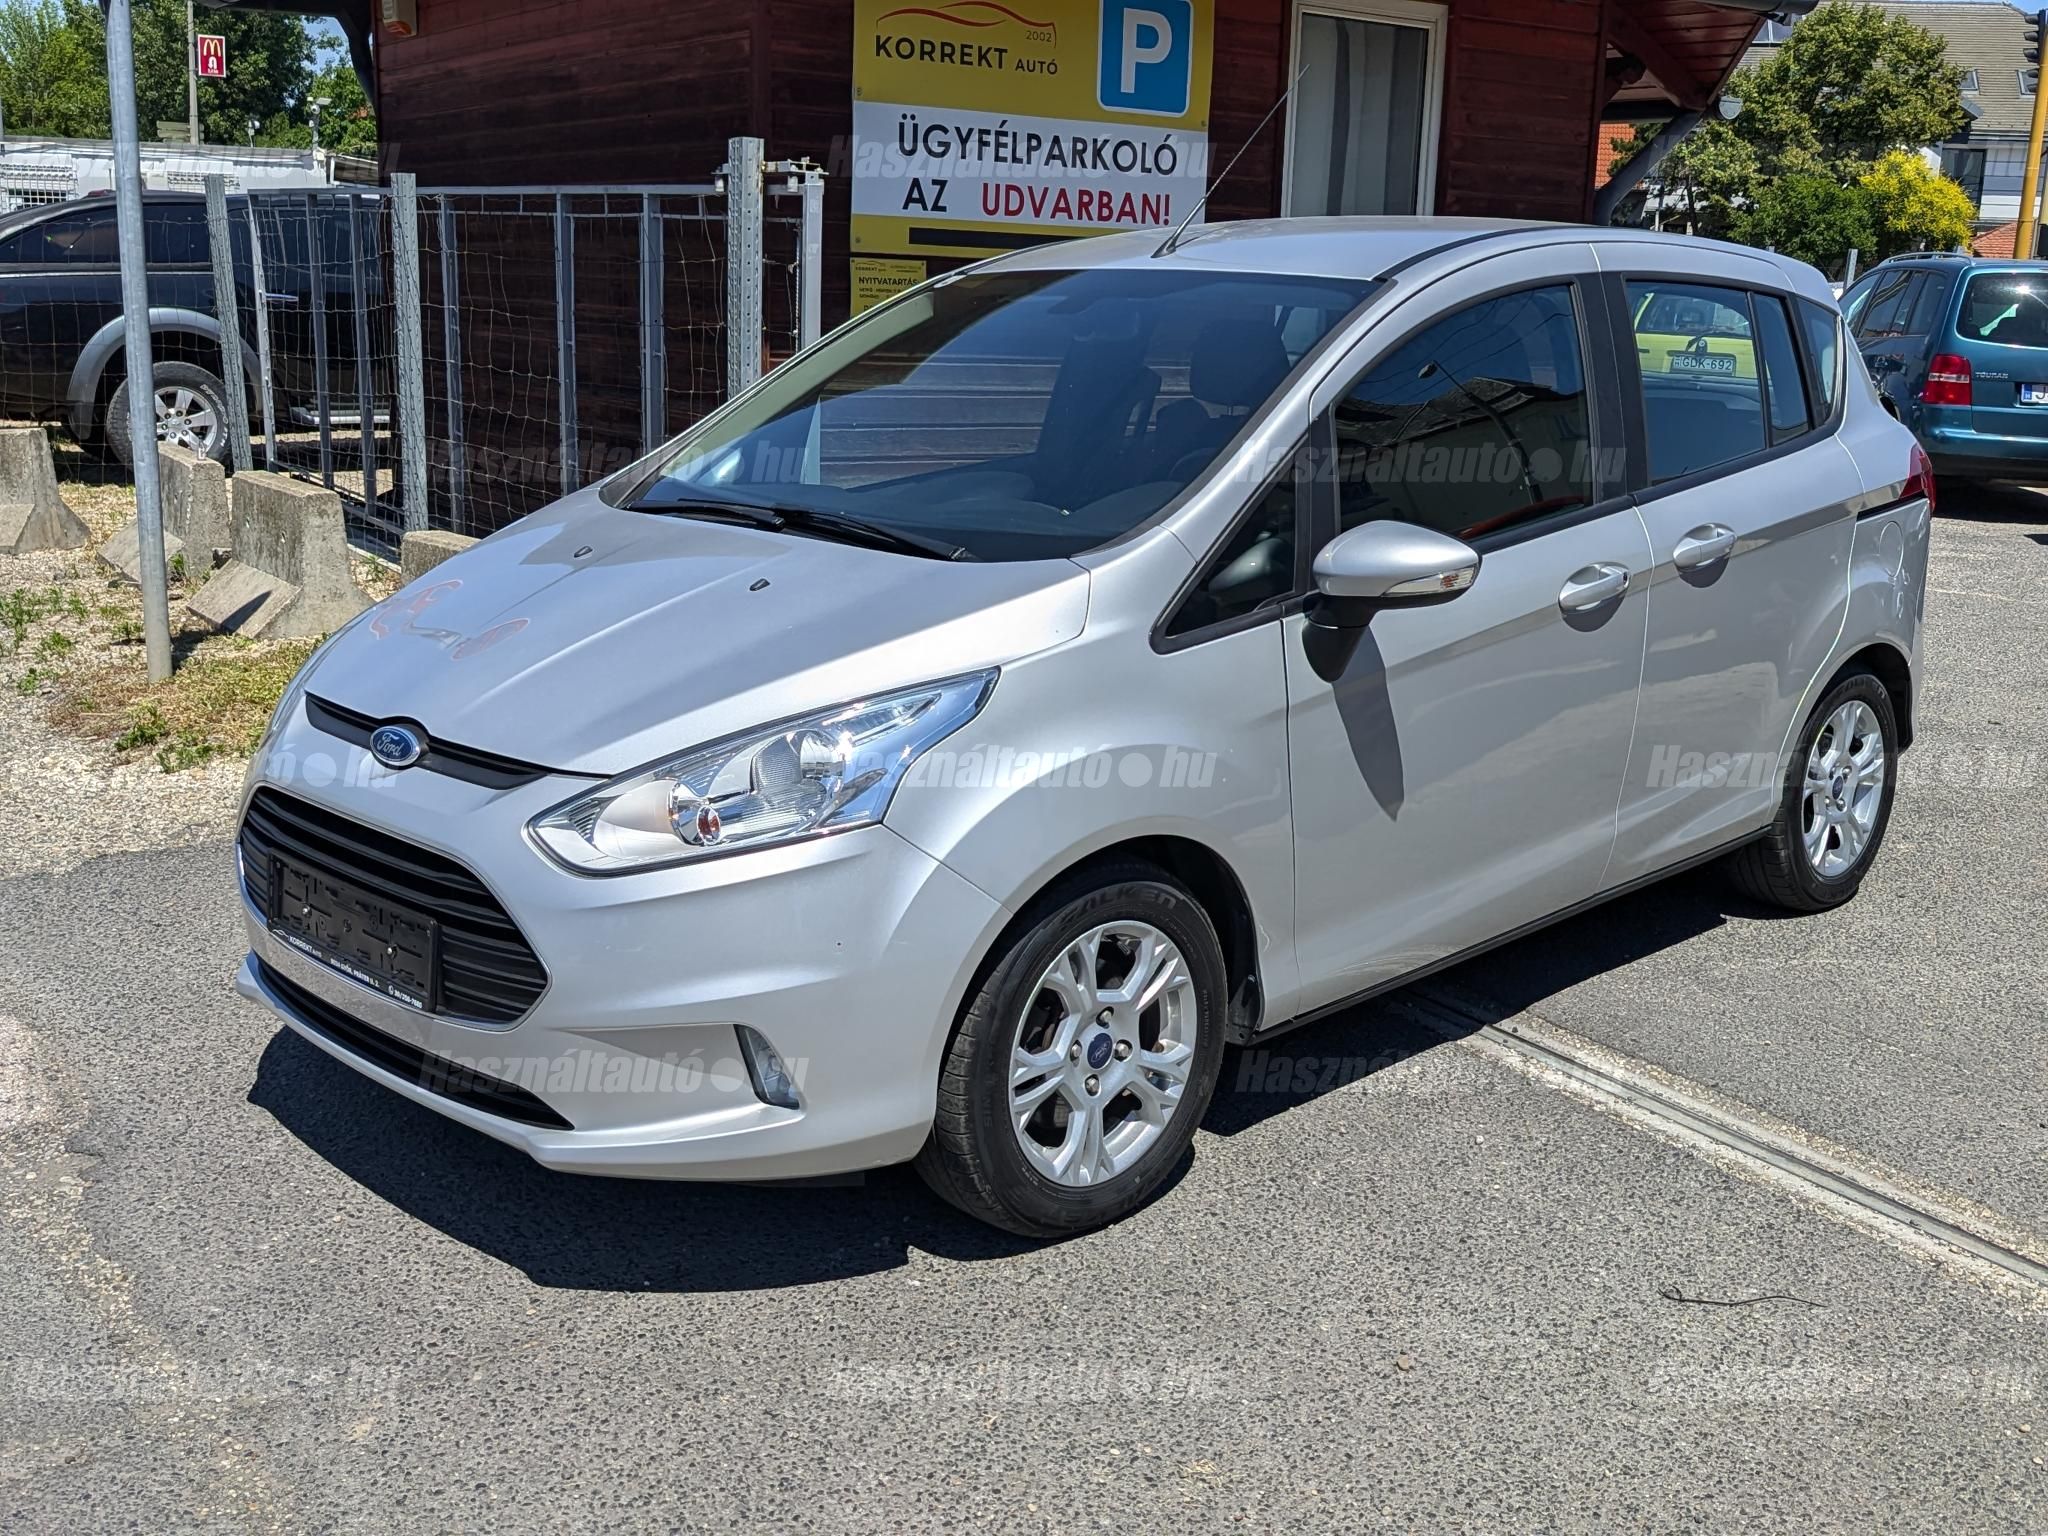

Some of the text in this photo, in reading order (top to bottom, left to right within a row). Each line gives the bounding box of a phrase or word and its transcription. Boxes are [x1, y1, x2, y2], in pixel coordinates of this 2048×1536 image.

[875, 35, 1058, 75] KORREKT AUTÓ
[1025, 30, 1051, 42] 2002
[1121, 8, 1172, 93] P
[899, 113, 1178, 176] ÜGYFÉLPARKOLÓ
[902, 178, 1171, 226] AZ UDVARBAN!
[1682, 357, 1732, 370] GDK-692
[376, 732, 405, 756] Ford
